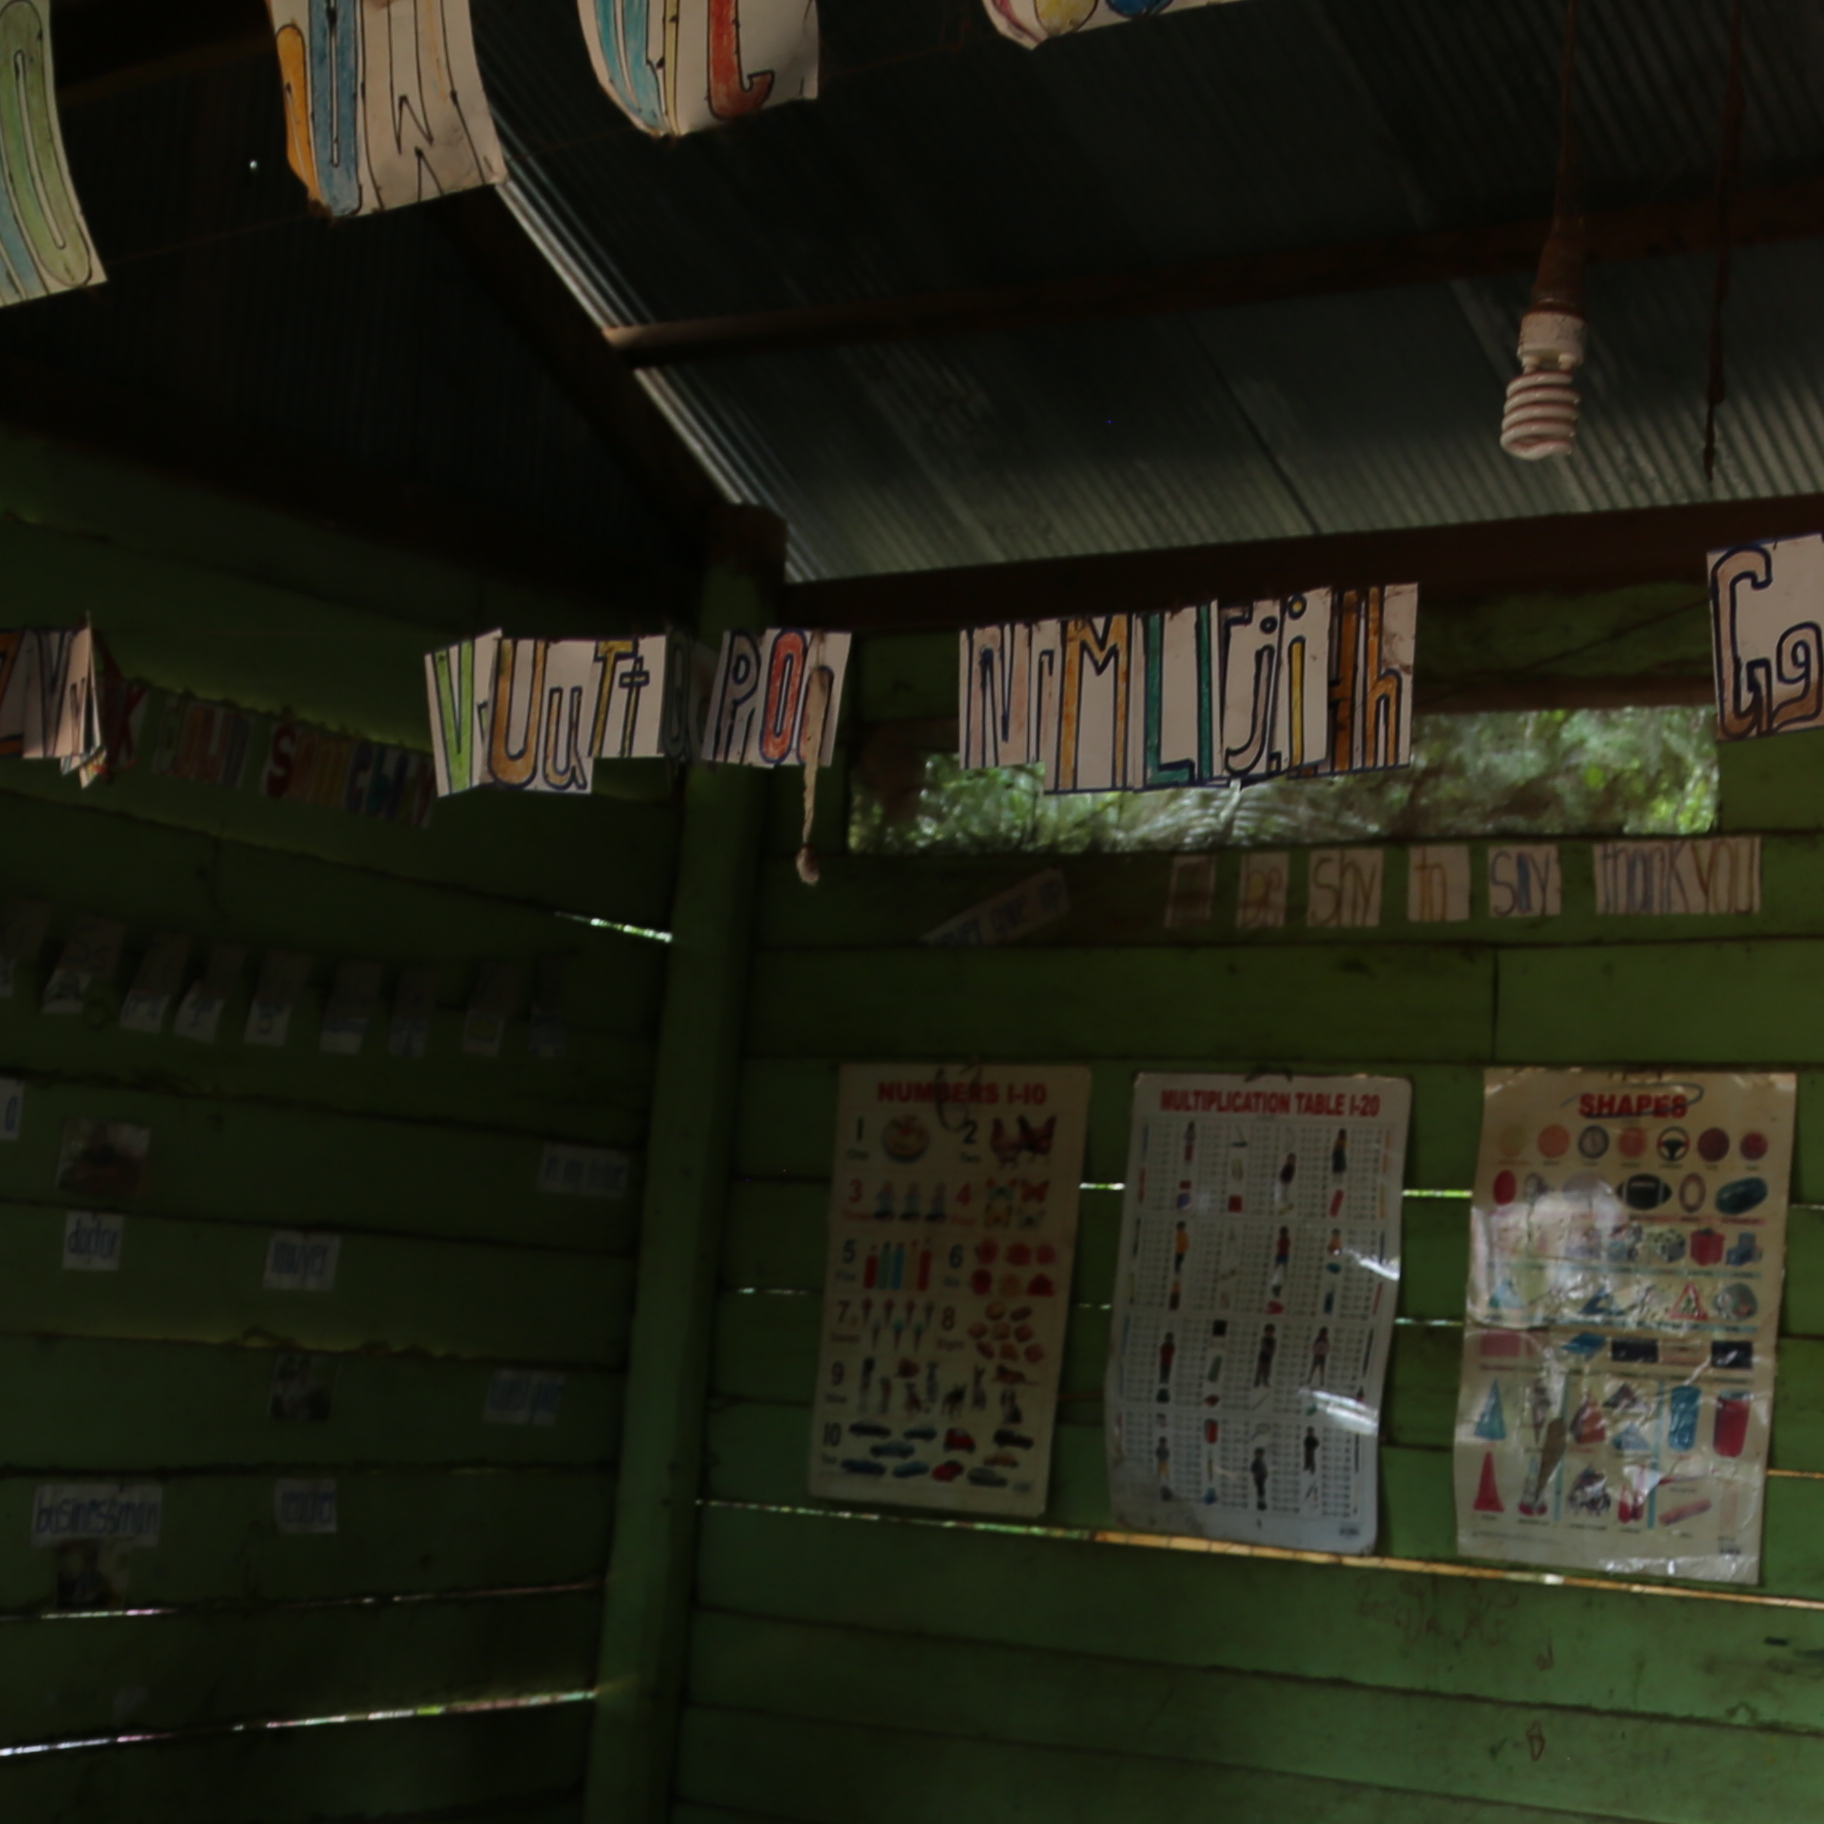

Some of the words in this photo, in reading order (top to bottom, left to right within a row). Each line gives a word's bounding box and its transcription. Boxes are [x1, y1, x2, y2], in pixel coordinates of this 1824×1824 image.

[1712, 545, 1824, 736] Gg
[588, 638, 649, 758] Tt
[489, 638, 586, 789] Uu
[1160, 1089, 1290, 1115] MULTIPLICATION
[1579, 1092, 1687, 1119] SHAPES
[857, 1117, 864, 1141] 1
[963, 1120, 978, 1144] 2
[850, 1178, 862, 1203] 3
[956, 1182, 971, 1205] 4
[68, 1220, 118, 1258] doctor
[842, 1239, 857, 1263] 5
[949, 1244, 963, 1268] 6
[838, 1300, 849, 1324] 7
[941, 1306, 955, 1331] 8
[831, 1361, 844, 1386] 9
[824, 1422, 841, 1447] 10
[35, 1495, 157, 1535] businessman
